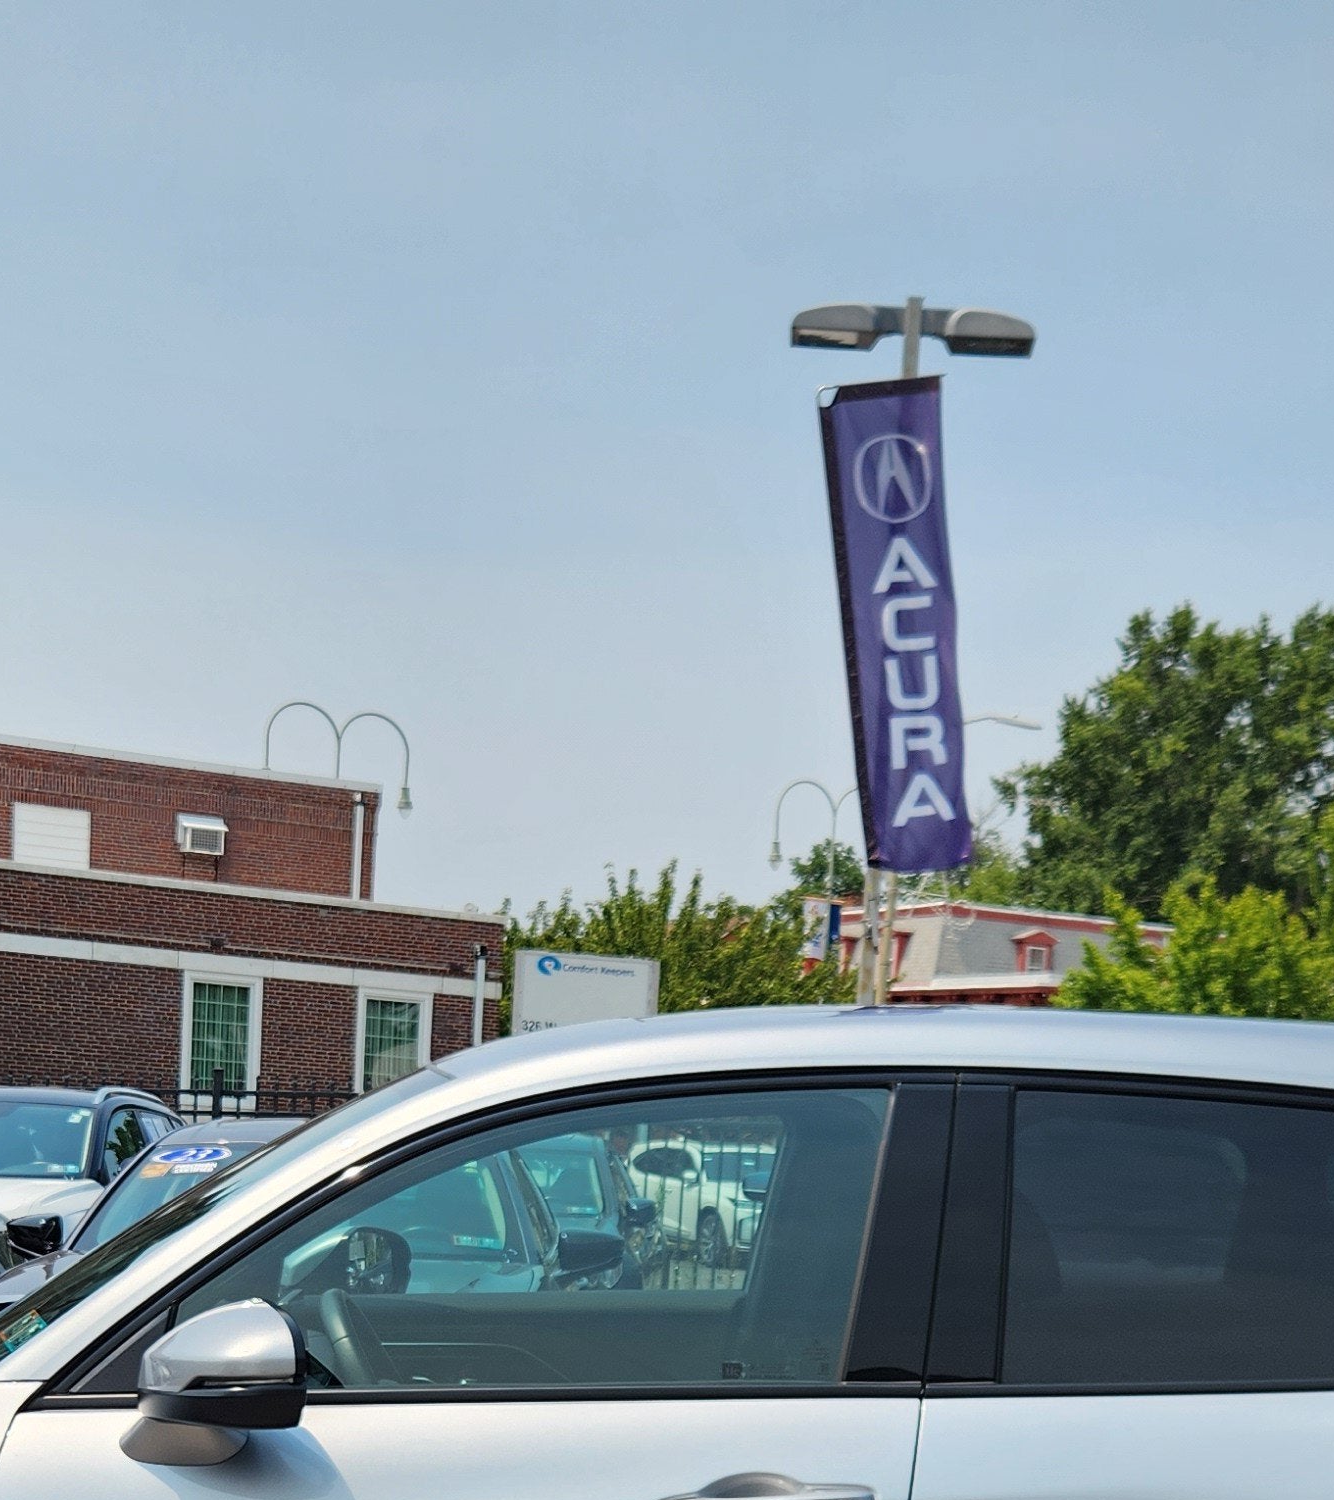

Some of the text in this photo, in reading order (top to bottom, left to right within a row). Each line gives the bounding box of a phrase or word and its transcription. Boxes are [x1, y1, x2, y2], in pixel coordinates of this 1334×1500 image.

[872, 537, 957, 828] ACURA
[563, 963, 636, 978] Comfort Keepers
